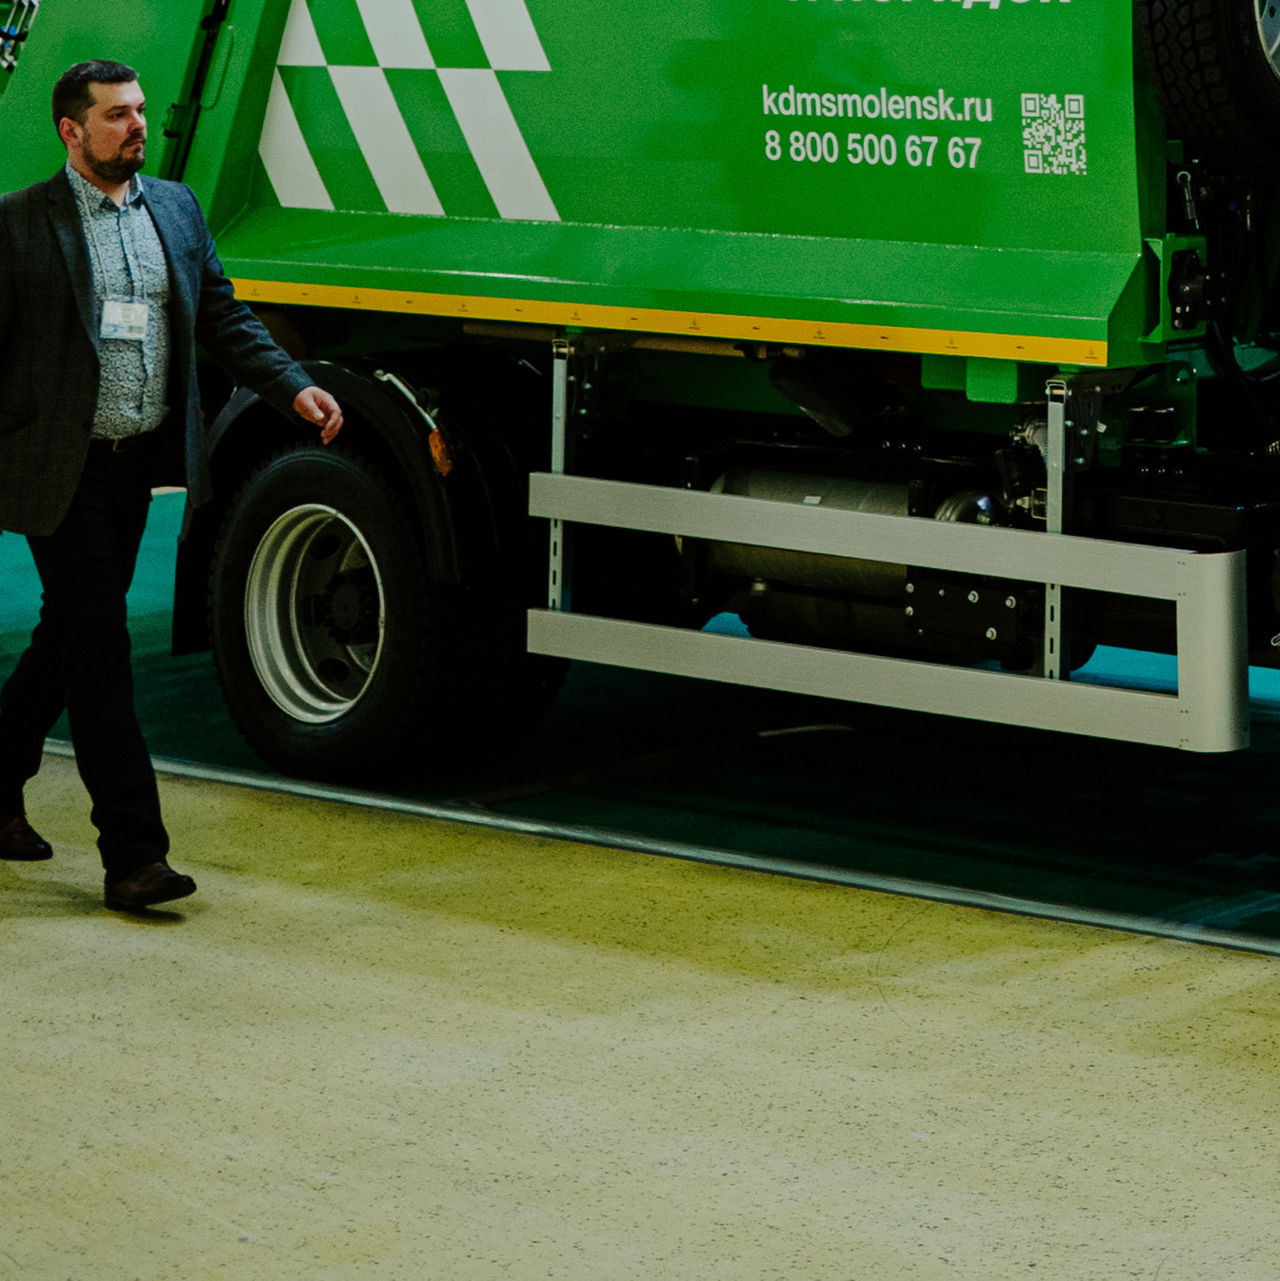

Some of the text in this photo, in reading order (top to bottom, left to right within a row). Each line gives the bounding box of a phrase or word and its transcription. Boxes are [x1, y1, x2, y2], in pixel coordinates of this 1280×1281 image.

[762, 84, 993, 122] kdmsmolensk.ru
[765, 130, 982, 169] 8 800 500 67 67
